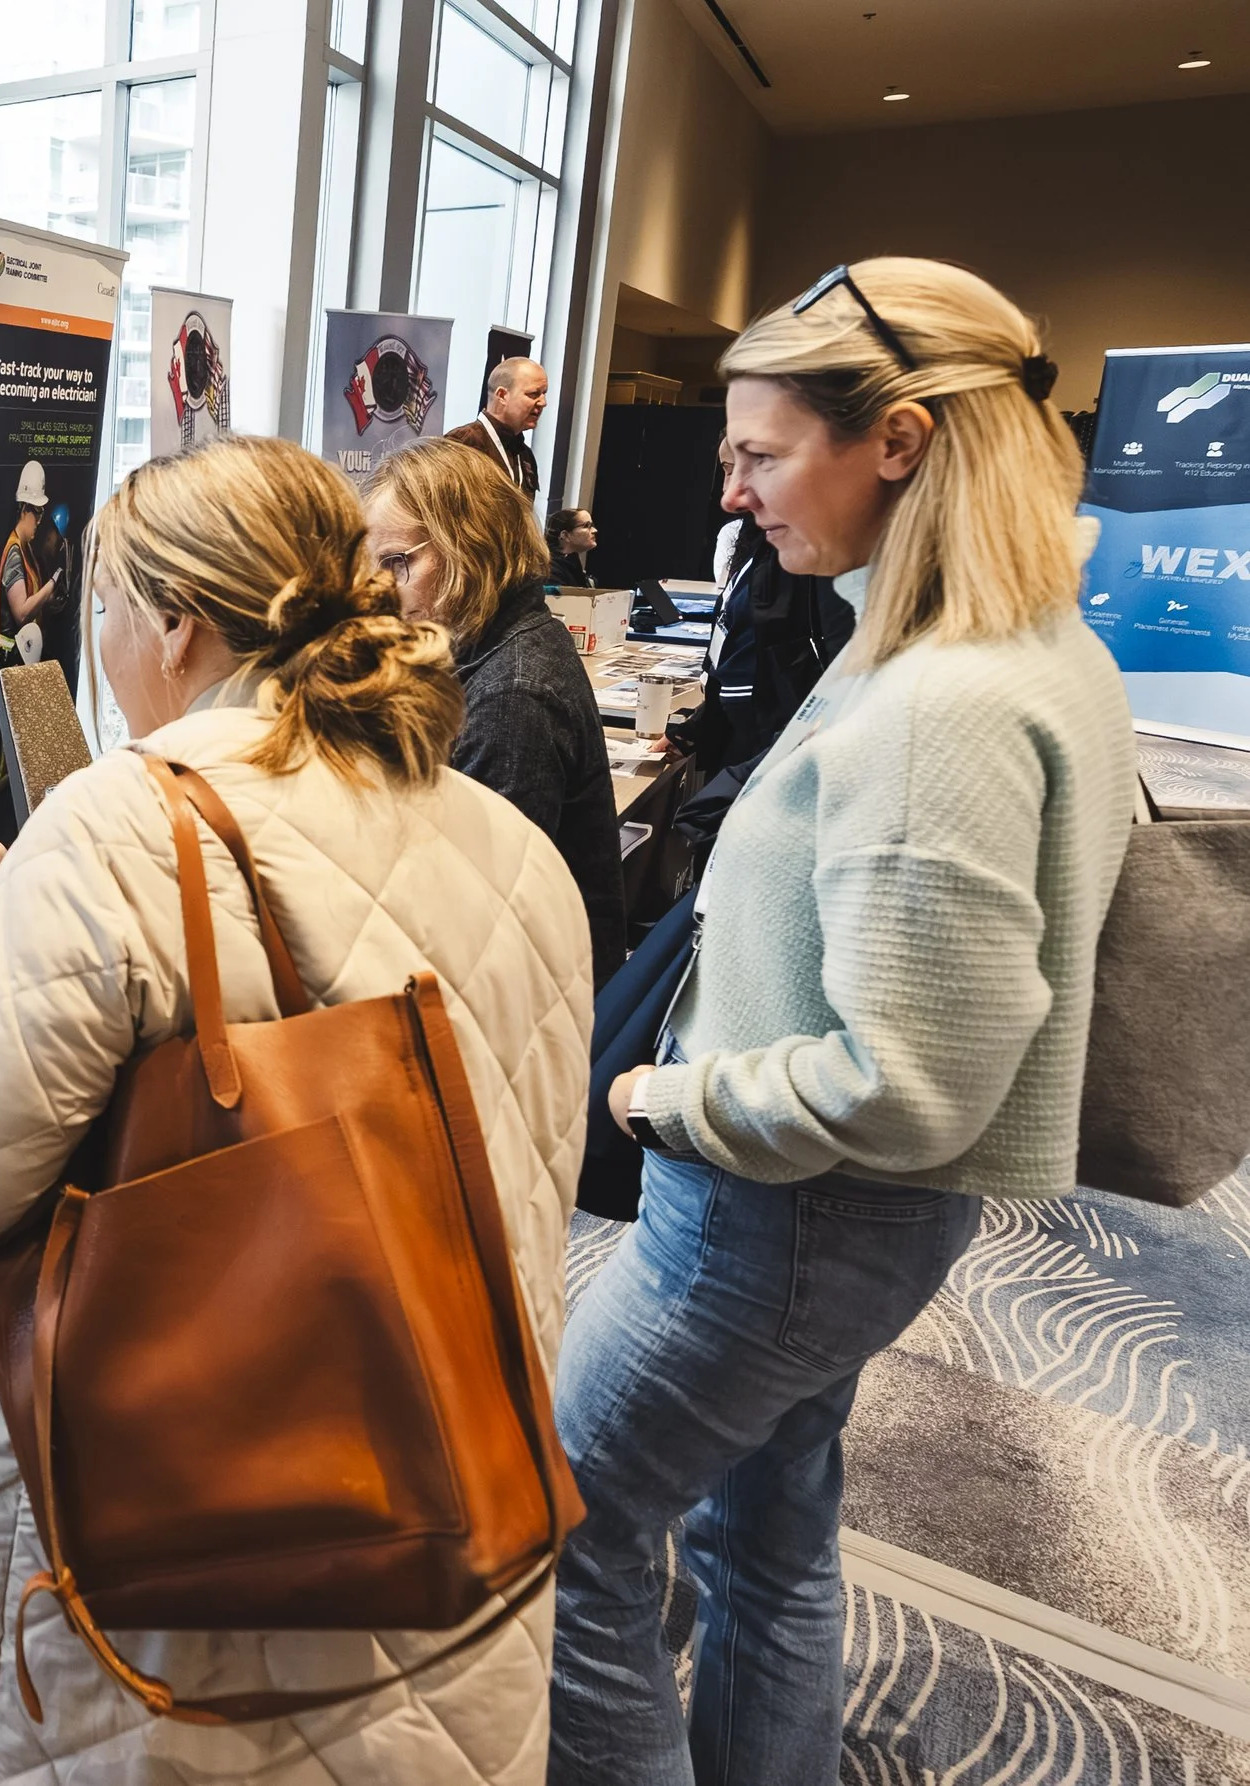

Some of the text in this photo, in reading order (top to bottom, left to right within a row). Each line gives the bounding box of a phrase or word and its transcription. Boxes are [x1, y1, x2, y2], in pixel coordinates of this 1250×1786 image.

[43, 367, 64, 382] your
[66, 369, 83, 386] way
[84, 369, 93, 384] to
[1222, 373, 1250, 382] DUA
[39, 386, 50, 398] an
[52, 385, 97, 402] electrician!
[70, 436, 92, 444] SUPPORT
[1094, 468, 1136, 476] Management
[1142, 544, 1250, 581] WEX
